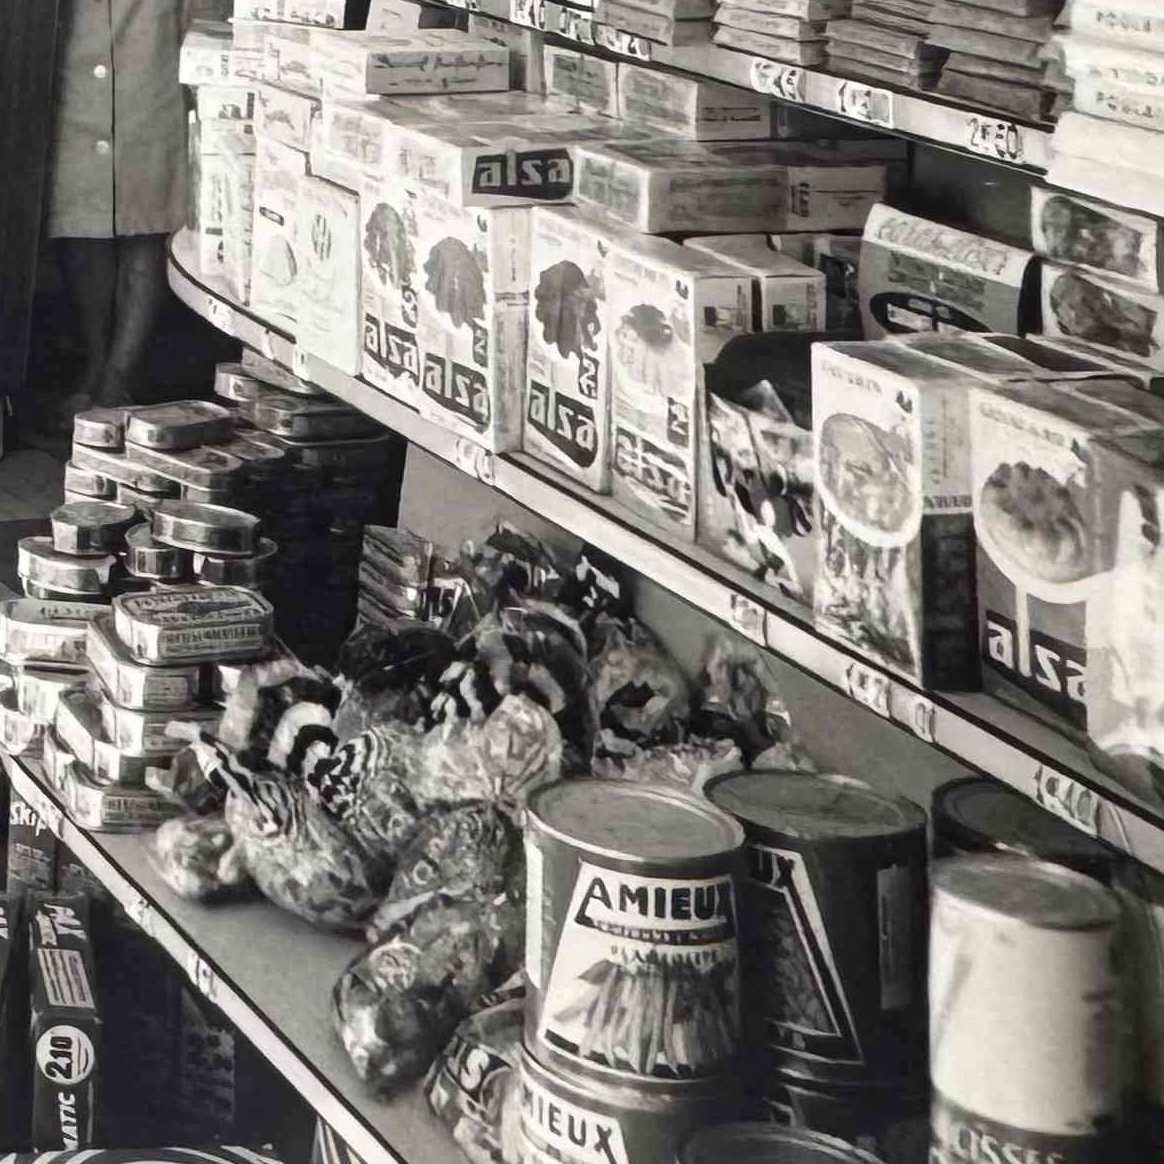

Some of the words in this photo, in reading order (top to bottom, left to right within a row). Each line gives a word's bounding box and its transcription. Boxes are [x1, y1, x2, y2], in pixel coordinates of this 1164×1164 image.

[478, 149, 572, 188] alsa
[363, 318, 420, 376] alsa
[424, 356, 491, 425] alsa
[530, 385, 597, 452] alsa
[986, 600, 1088, 705] alsa
[574, 876, 732, 927] AMIEUX
